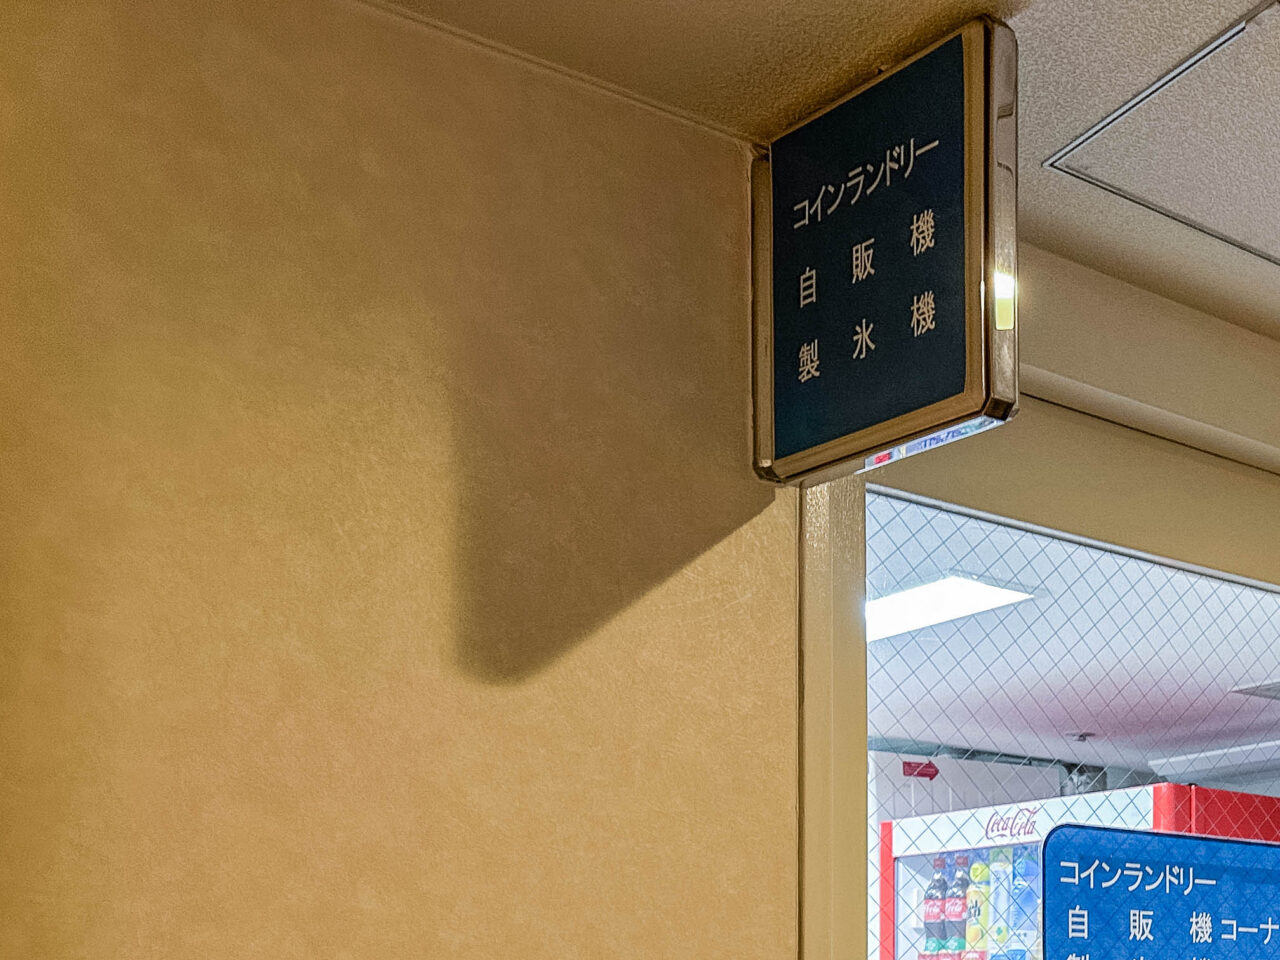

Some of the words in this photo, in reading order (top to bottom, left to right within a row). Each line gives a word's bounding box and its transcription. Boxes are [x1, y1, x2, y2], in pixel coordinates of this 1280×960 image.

[793, 136, 940, 230] コインランドリー
[986, 807, 1037, 840] Coca-Cola
[1059, 858, 1217, 896] コインランドリー
